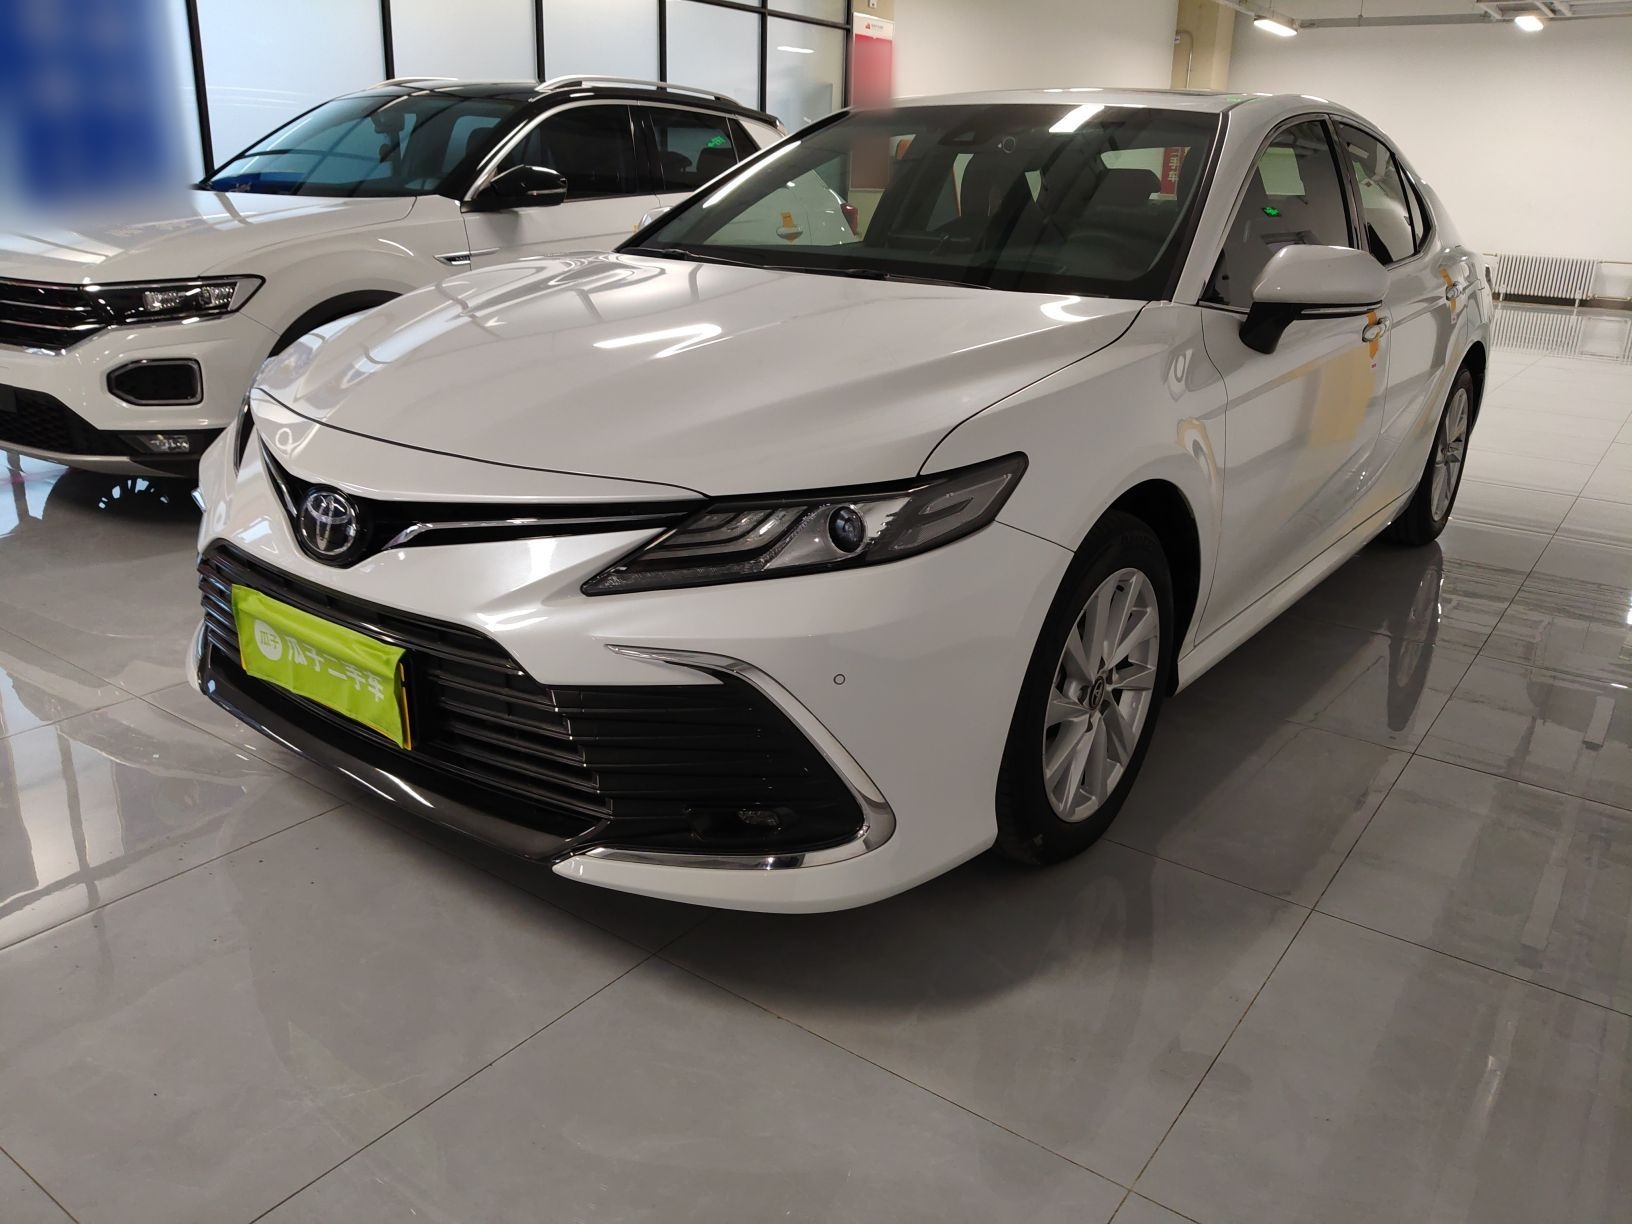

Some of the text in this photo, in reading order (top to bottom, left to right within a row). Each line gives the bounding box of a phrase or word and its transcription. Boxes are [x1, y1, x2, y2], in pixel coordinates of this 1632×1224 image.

[285, 636, 385, 702] 瓜子二手车
